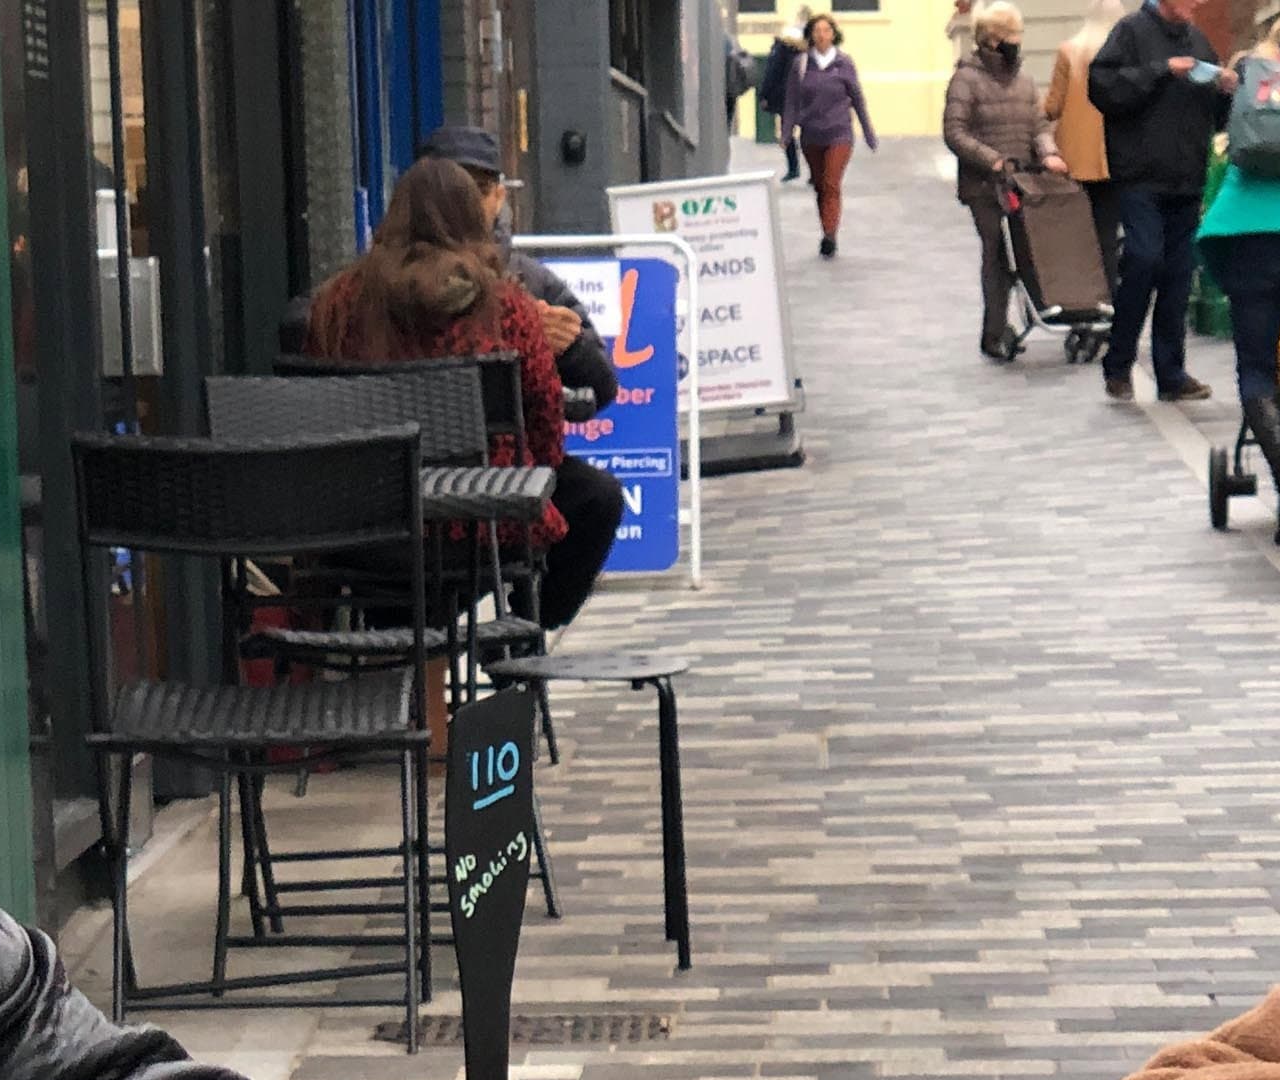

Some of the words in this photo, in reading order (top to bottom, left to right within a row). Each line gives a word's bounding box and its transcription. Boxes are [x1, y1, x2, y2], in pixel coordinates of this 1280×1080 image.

[699, 257, 756, 277] ANDS
[700, 304, 742, 322] ACE
[615, 386, 655, 405] ber
[611, 456, 667, 471] Piercing
[622, 484, 642, 515] N
[615, 525, 642, 540] un
[471, 741, 520, 791] 110
